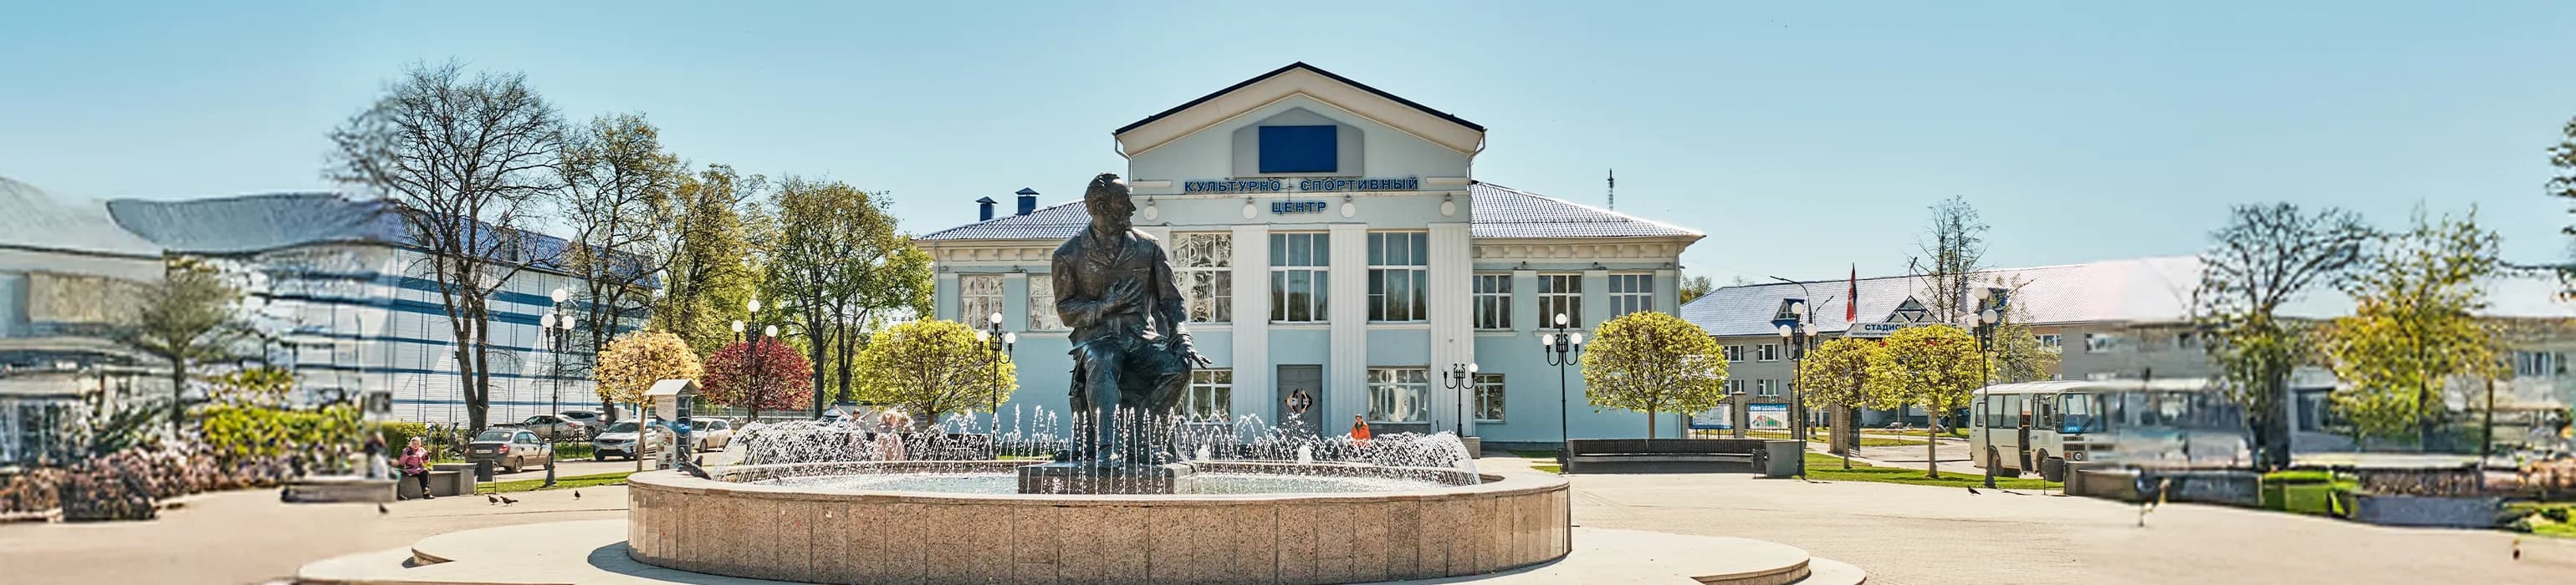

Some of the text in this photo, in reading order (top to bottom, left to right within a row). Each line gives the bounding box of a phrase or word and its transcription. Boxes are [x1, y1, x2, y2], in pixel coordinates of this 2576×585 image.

[1184, 180, 1281, 193] КУЛЬТУРНО
[1300, 176, 1419, 191] СПОРТИВНЫЙ
[1271, 201, 1326, 215] ЦЕНТР
